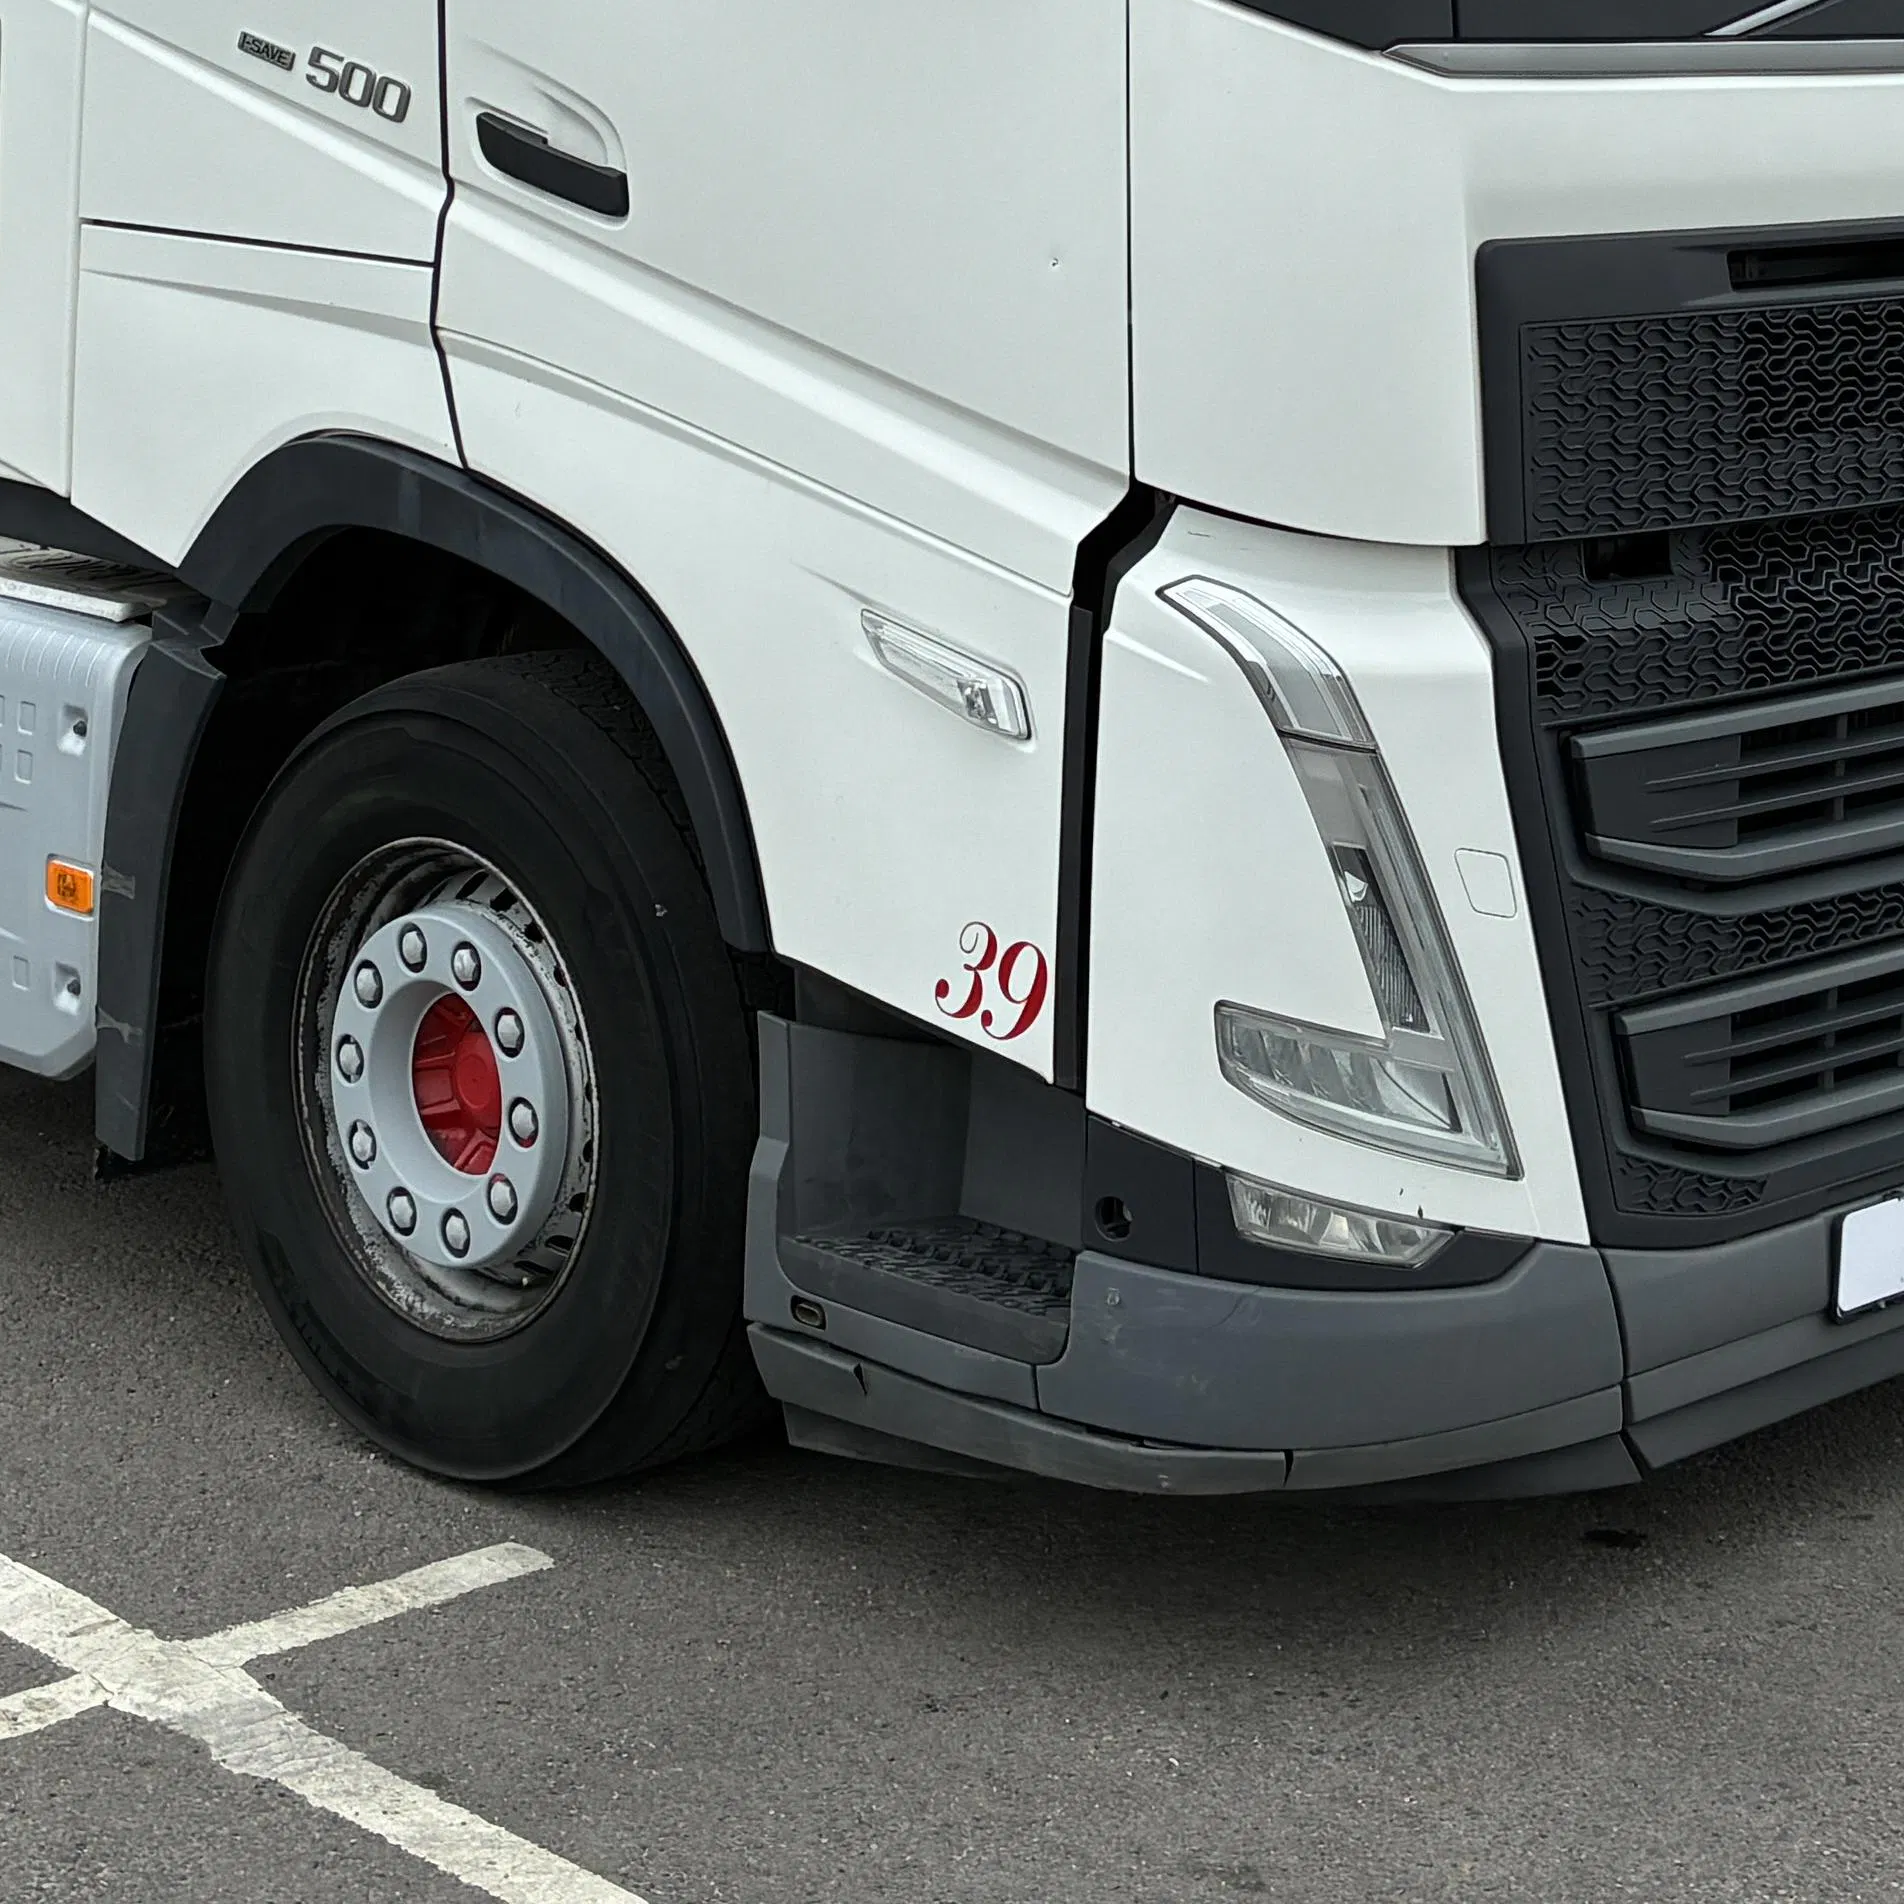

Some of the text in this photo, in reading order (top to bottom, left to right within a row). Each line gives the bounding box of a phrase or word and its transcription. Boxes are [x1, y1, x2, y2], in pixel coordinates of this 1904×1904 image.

[240, 32, 412, 124] I-SAVE 500
[934, 920, 1049, 1042] 39
